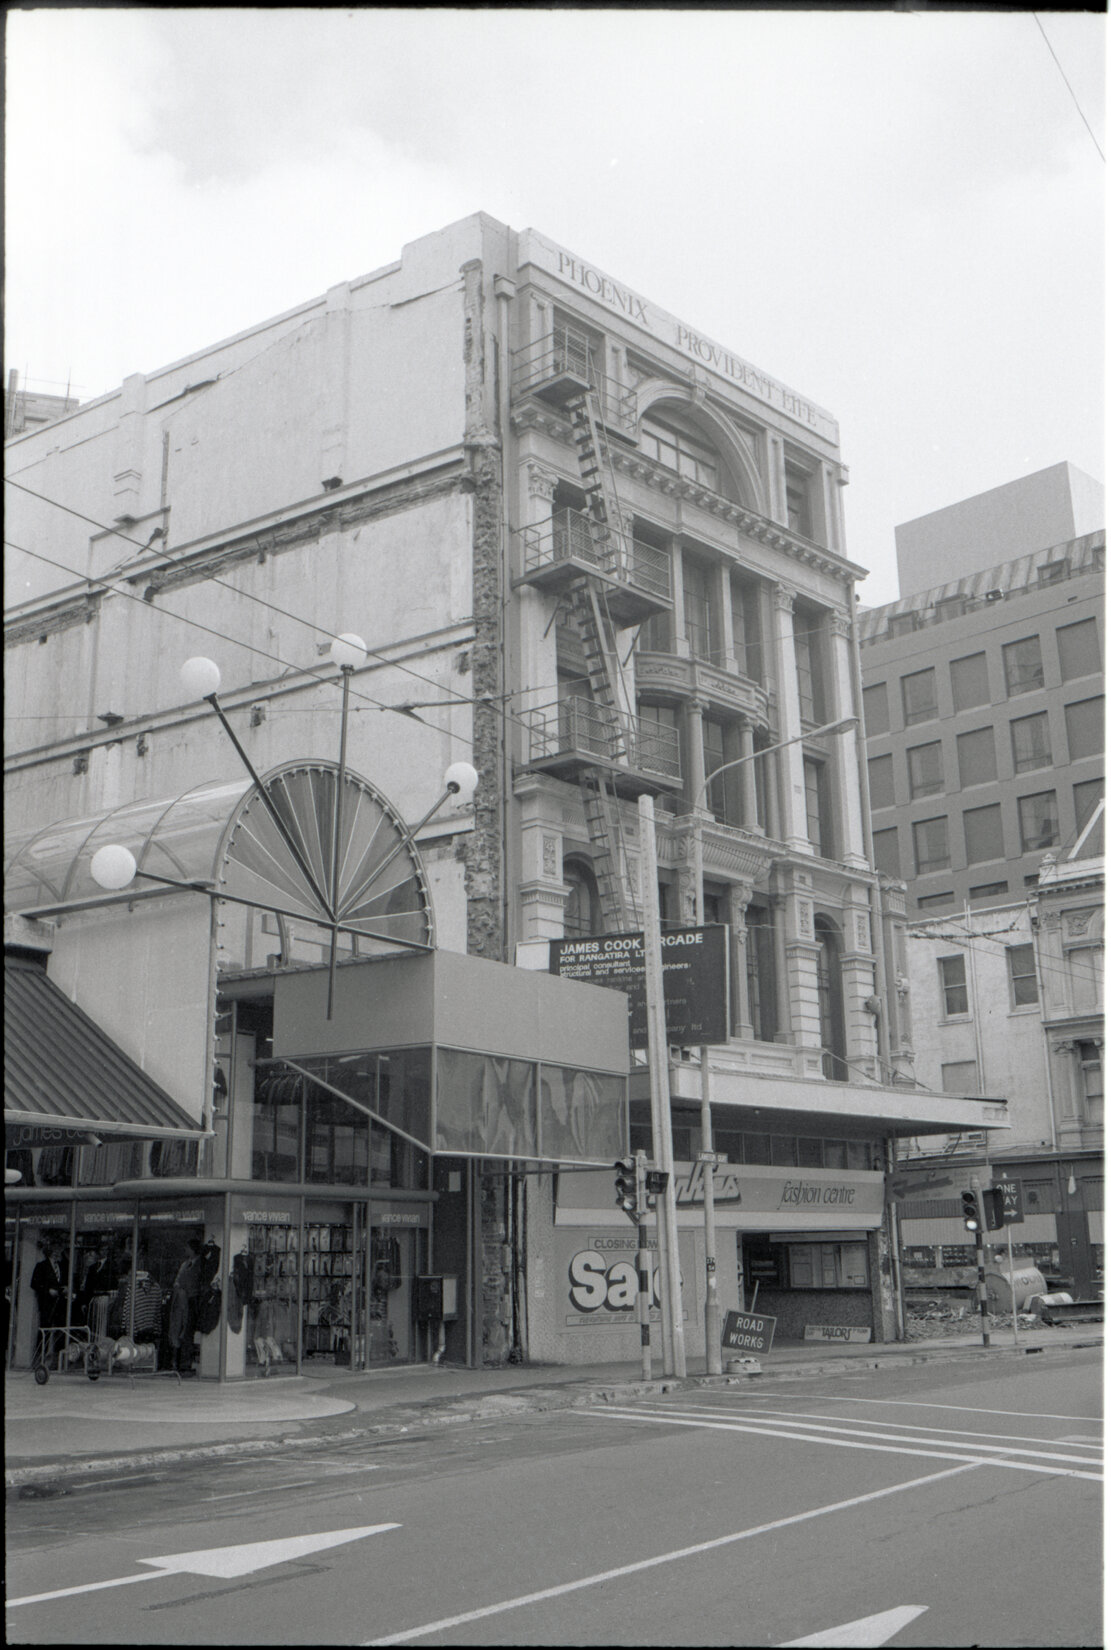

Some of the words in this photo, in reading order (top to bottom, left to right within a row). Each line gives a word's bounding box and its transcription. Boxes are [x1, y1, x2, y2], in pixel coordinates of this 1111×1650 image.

[558, 251, 649, 325] PHOENIX
[675, 323, 775, 400] PROVIDENT
[781, 388, 817, 427] LIFE
[560, 942, 600, 955] JAMES
[604, 938, 642, 951] COOK
[661, 933, 704, 947] RCADE
[560, 955, 576, 964] FOR
[579, 950, 631, 962] RANGATIRA
[635, 949, 646, 958] LT
[560, 962, 590, 973] principal
[593, 960, 631, 970] consultant
[596, 967, 610, 976] and
[776, 1180, 821, 1211] fashion
[824, 1185, 856, 1205] centre
[1004, 1195, 1018, 1206] AY
[594, 1239, 637, 1250] CLOSING
[736, 1316, 764, 1332] ROAD
[730, 1331, 764, 1349] WORKS
